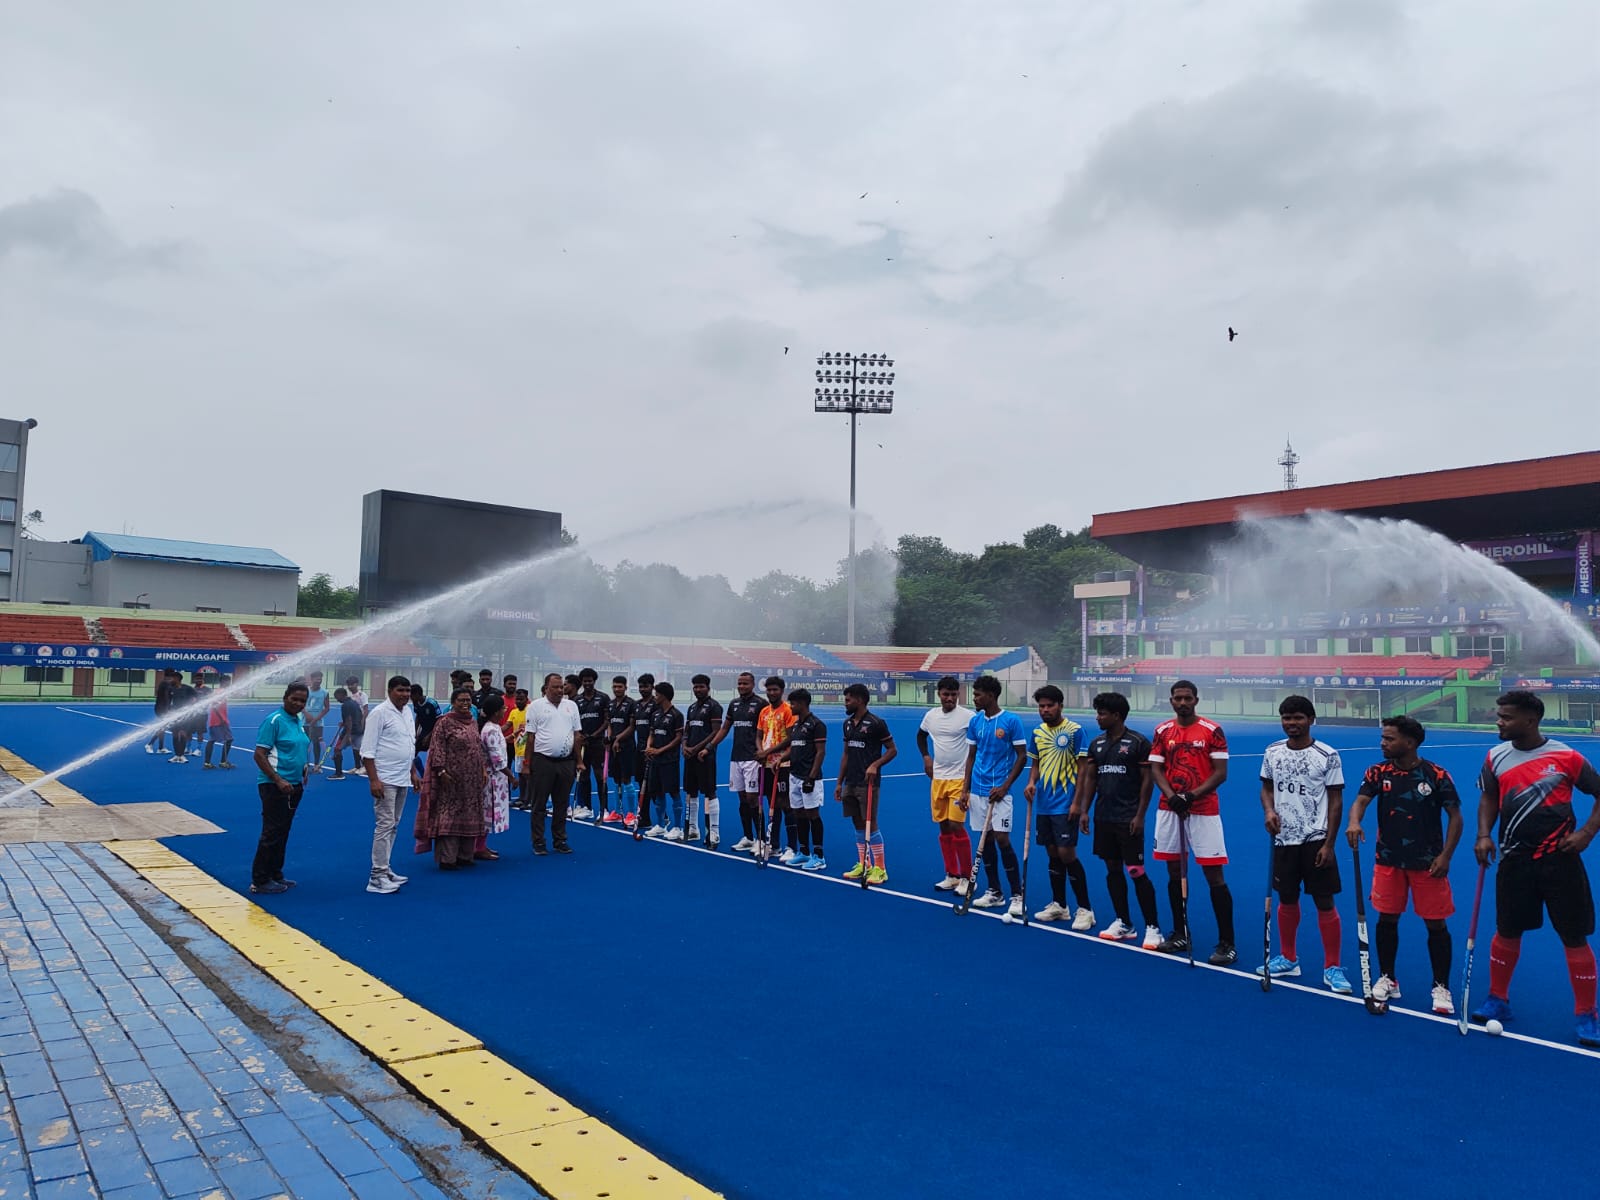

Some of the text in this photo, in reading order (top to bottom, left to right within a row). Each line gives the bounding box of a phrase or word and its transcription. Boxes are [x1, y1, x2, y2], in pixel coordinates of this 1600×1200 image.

[1474, 543, 1554, 558] HEROHIL
[1580, 541, 1589, 594] #HEROHIL
[155, 652, 231, 661] #INDIAKAGAME
[789, 682, 815, 690] JUNIOR
[815, 682, 842, 690] WOMEN
[1001, 818, 1010, 828] 16
